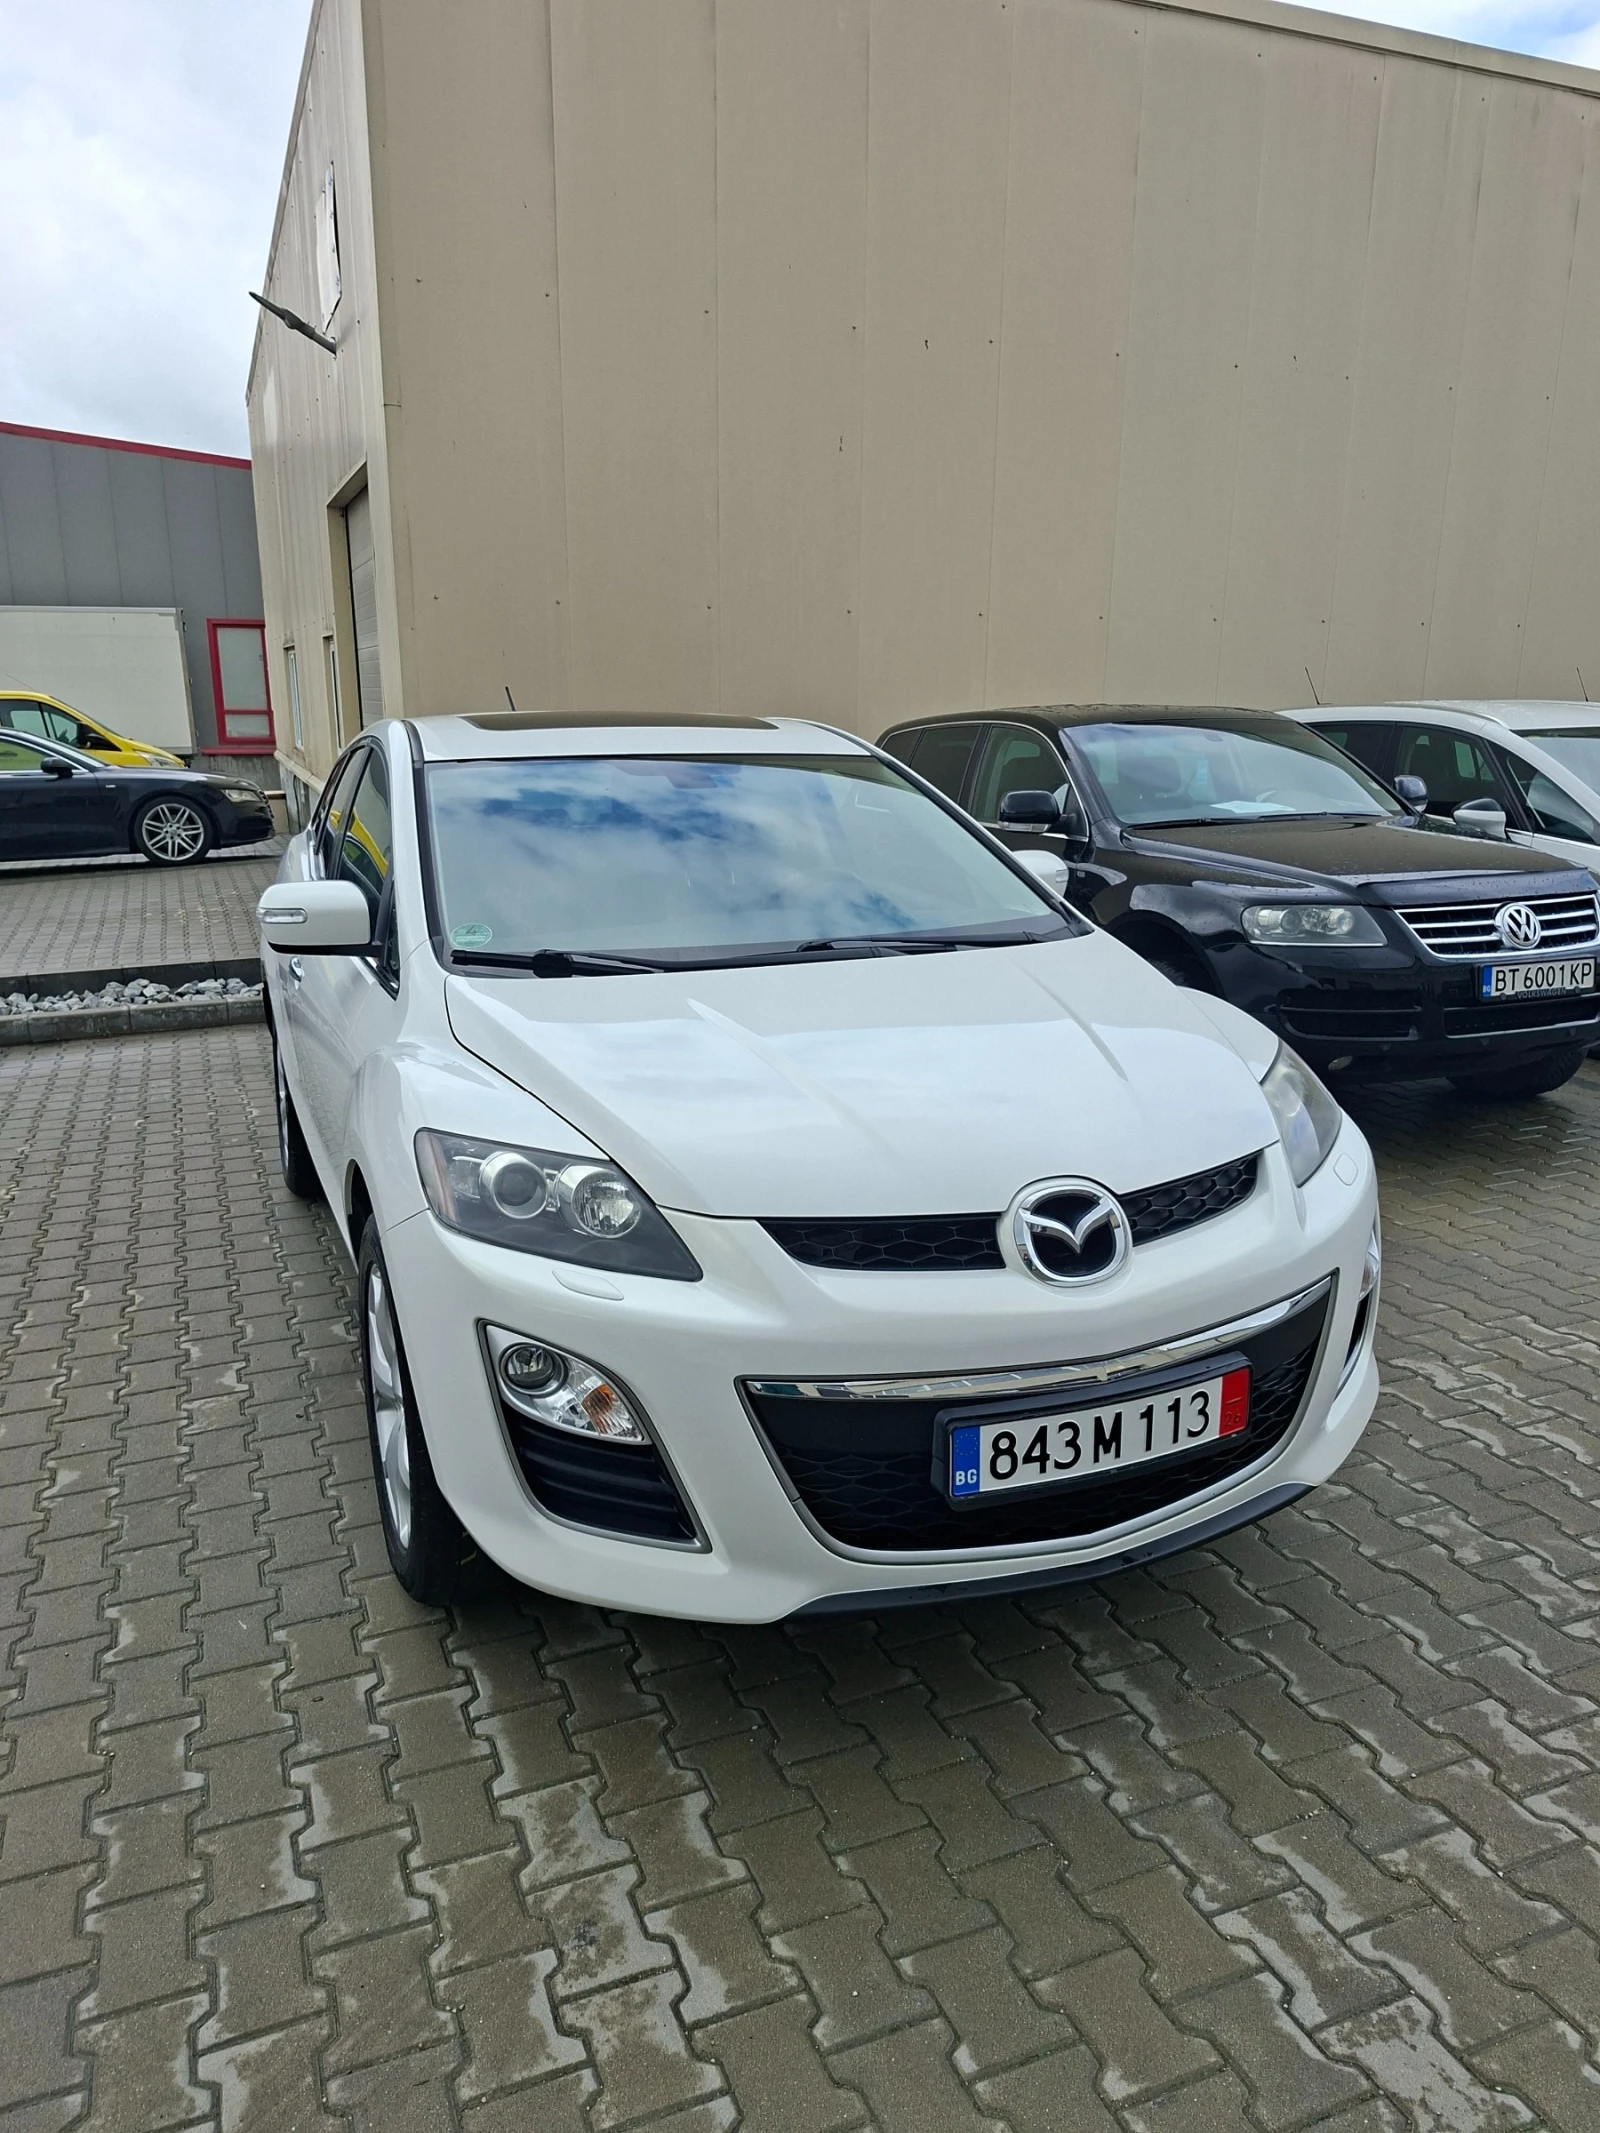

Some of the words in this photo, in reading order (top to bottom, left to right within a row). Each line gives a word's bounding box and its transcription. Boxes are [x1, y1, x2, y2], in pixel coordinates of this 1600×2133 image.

[1495, 968, 1520, 992] BT
[1523, 964, 1565, 989] 6001
[1570, 962, 1592, 986] KP
[1517, 987, 1567, 999] VOLKSWAGEN
[988, 1420, 1082, 1480] 843
[1093, 1410, 1122, 1464] M
[1139, 1390, 1210, 1452] 113
[955, 1468, 977, 1486] BG
